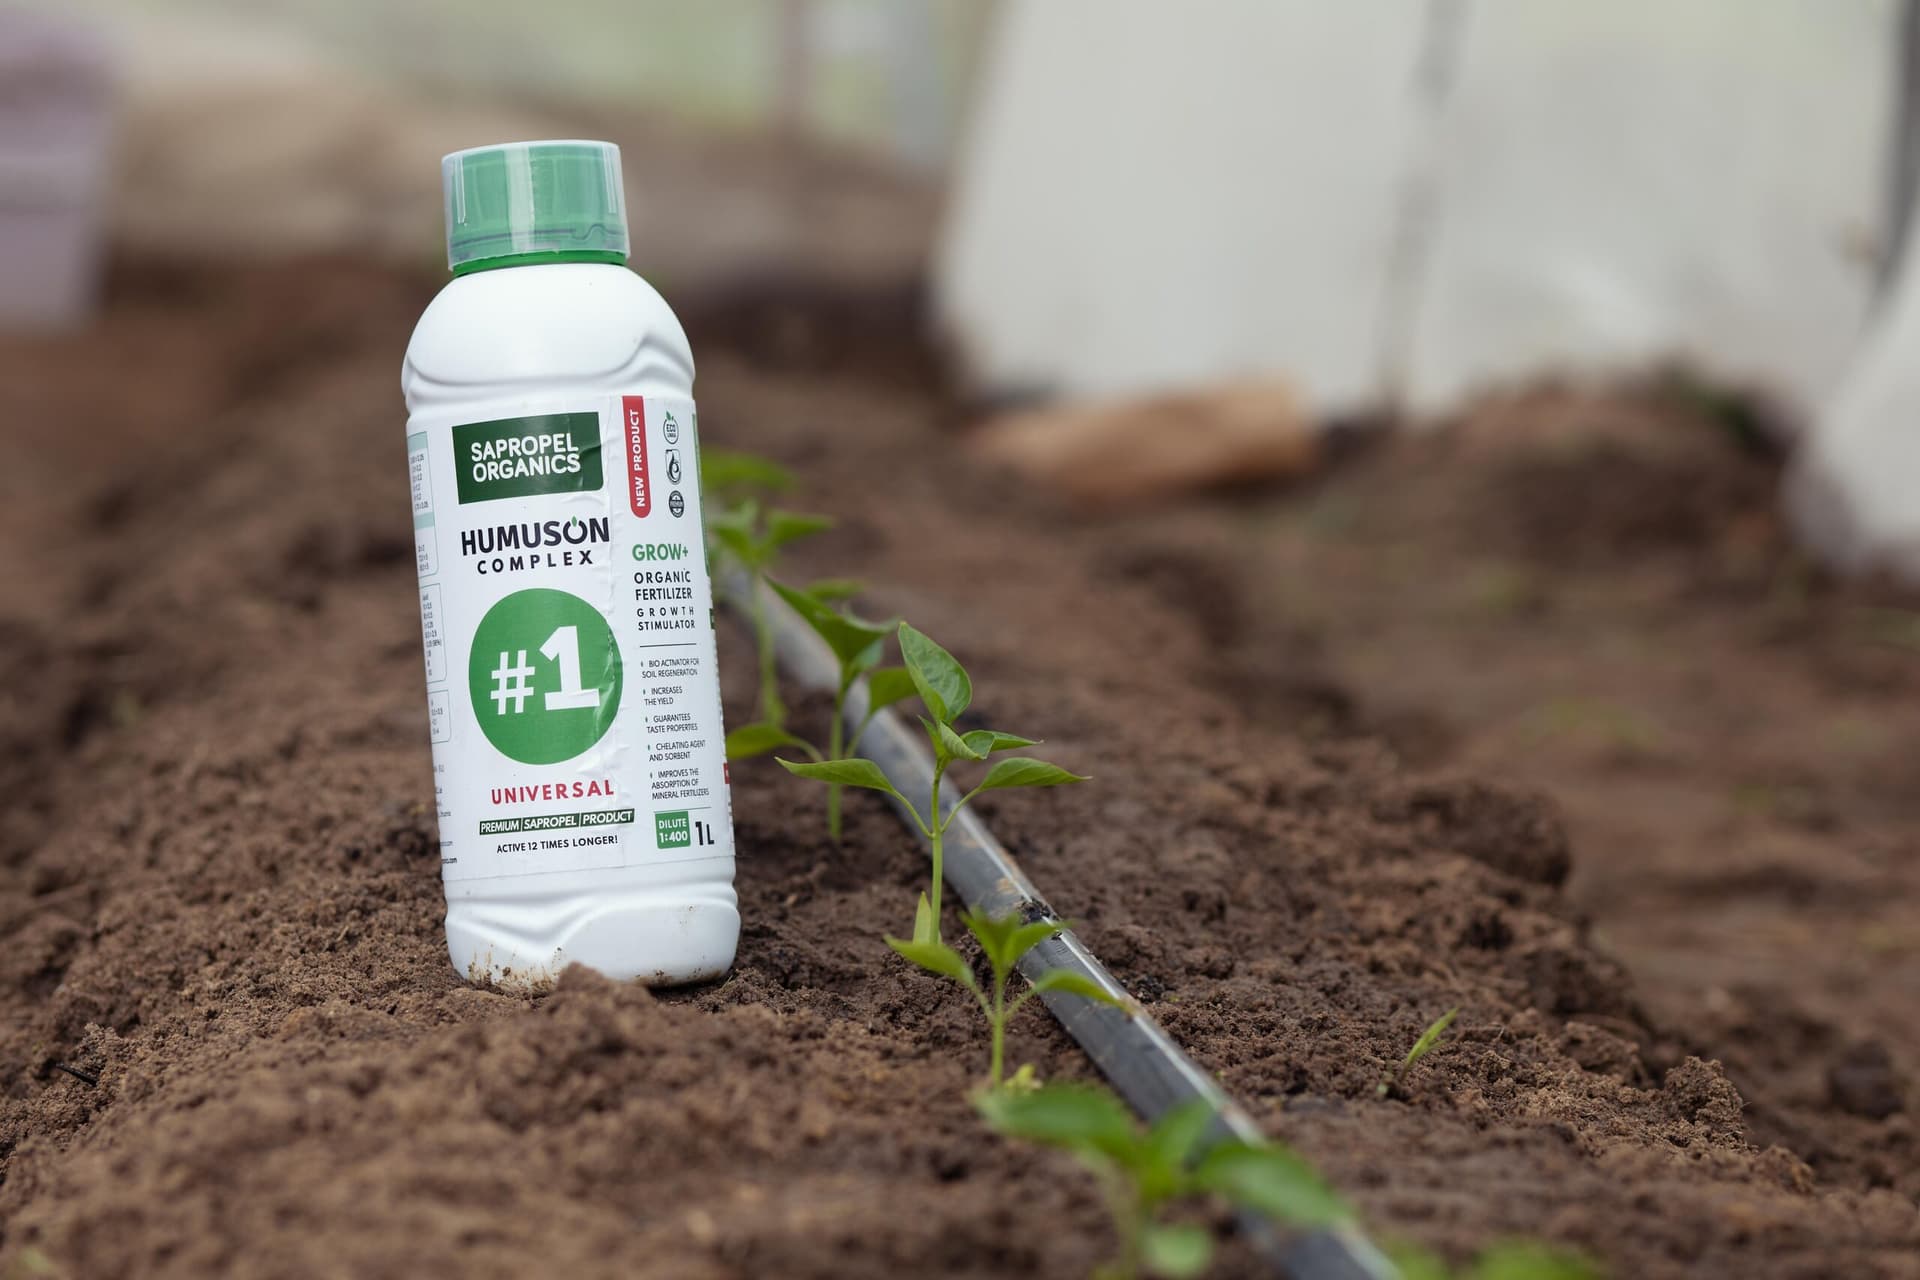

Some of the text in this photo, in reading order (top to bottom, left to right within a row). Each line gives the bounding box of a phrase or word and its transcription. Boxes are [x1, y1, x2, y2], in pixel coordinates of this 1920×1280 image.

[471, 433, 579, 462] SAPROPEL
[628, 409, 646, 508] NEW PRODUCT
[472, 453, 581, 483] ORGANICS
[461, 515, 610, 556] HUMUSON
[632, 543, 689, 561] GROW+
[477, 550, 593, 575] COMPLEX
[634, 570, 691, 584] ORGANIC
[635, 587, 693, 601] FERTILIZER
[636, 606, 694, 617] GROWTH
[638, 619, 696, 631] STIMULATOR
[490, 625, 600, 715] #1
[641, 670, 657, 679] SOIL
[651, 686, 683, 695] INCREASES
[644, 697, 674, 706] THE YIELD
[653, 713, 691, 723] GUARANTEES
[646, 725, 666, 734] TASTE
[656, 741, 689, 751] CHELATING
[649, 751, 691, 762] AND SORBENT
[657, 769, 689, 779] IMPROVES
[491, 779, 615, 805] UNIVERSAL
[651, 781, 691, 790] ABSORPTION
[652, 790, 679, 800] MINERAL
[480, 810, 633, 833] PREMIUM SAPROPEL PRODUCT
[658, 818, 688, 830] DILUTE
[659, 830, 688, 844] 1:400
[497, 834, 619, 854] ACTIVE 12 TIMES LONGER!
